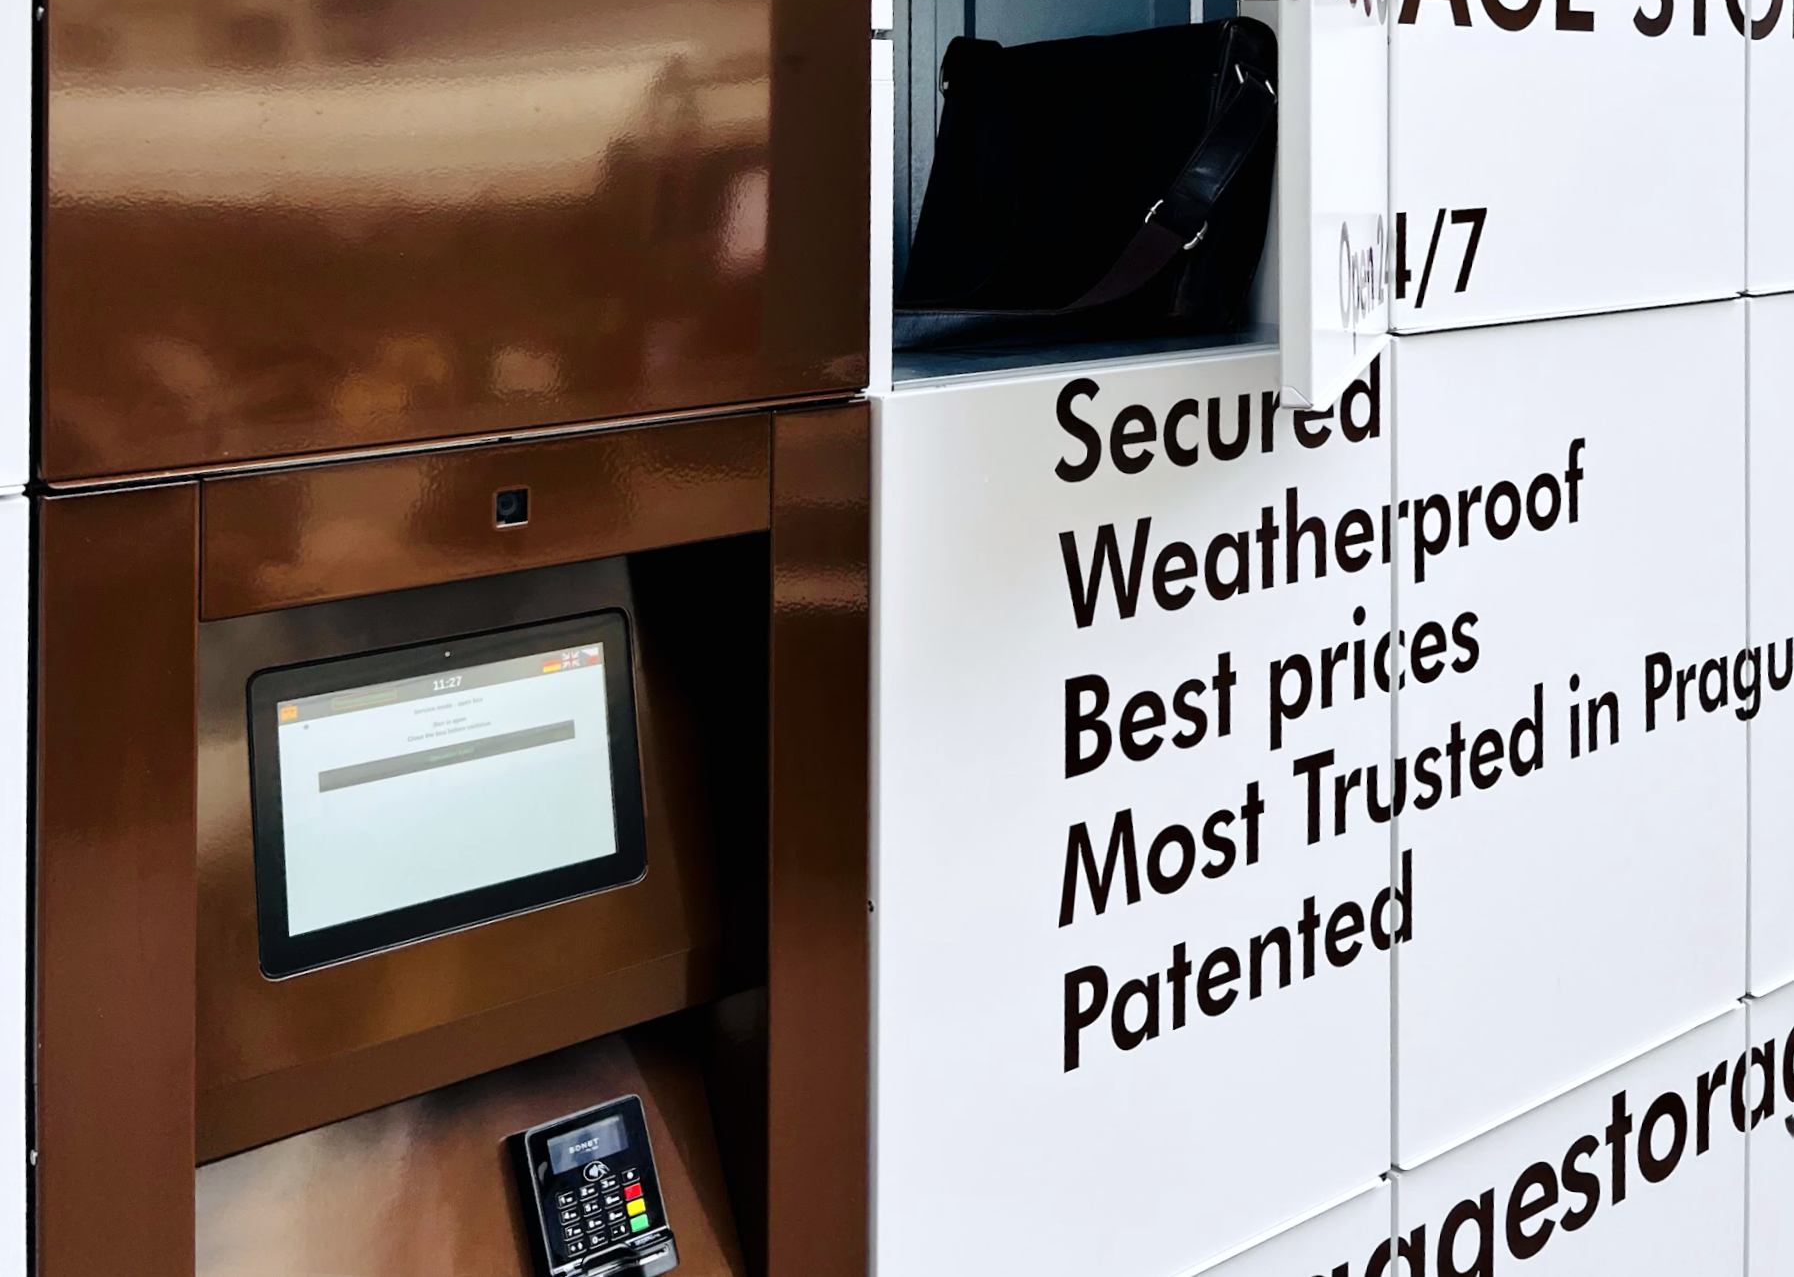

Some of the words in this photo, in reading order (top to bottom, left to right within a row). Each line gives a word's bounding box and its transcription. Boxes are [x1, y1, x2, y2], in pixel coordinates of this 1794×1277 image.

[1338, 220, 1375, 356] Open
[1054, 352, 1381, 483] Secured
[1058, 438, 1586, 629] Weatherproof
[433, 676, 462, 691] 11:27
[1065, 650, 1237, 779] Best
[1269, 606, 1480, 750] prices
[1059, 780, 1265, 928] Most
[1293, 682, 1545, 845] Trusted
[1570, 672, 1620, 759] in
[1645, 637, 1794, 733] Pragu
[1064, 848, 1414, 1073] Patented
[569, 1137, 599, 1154] SONET
